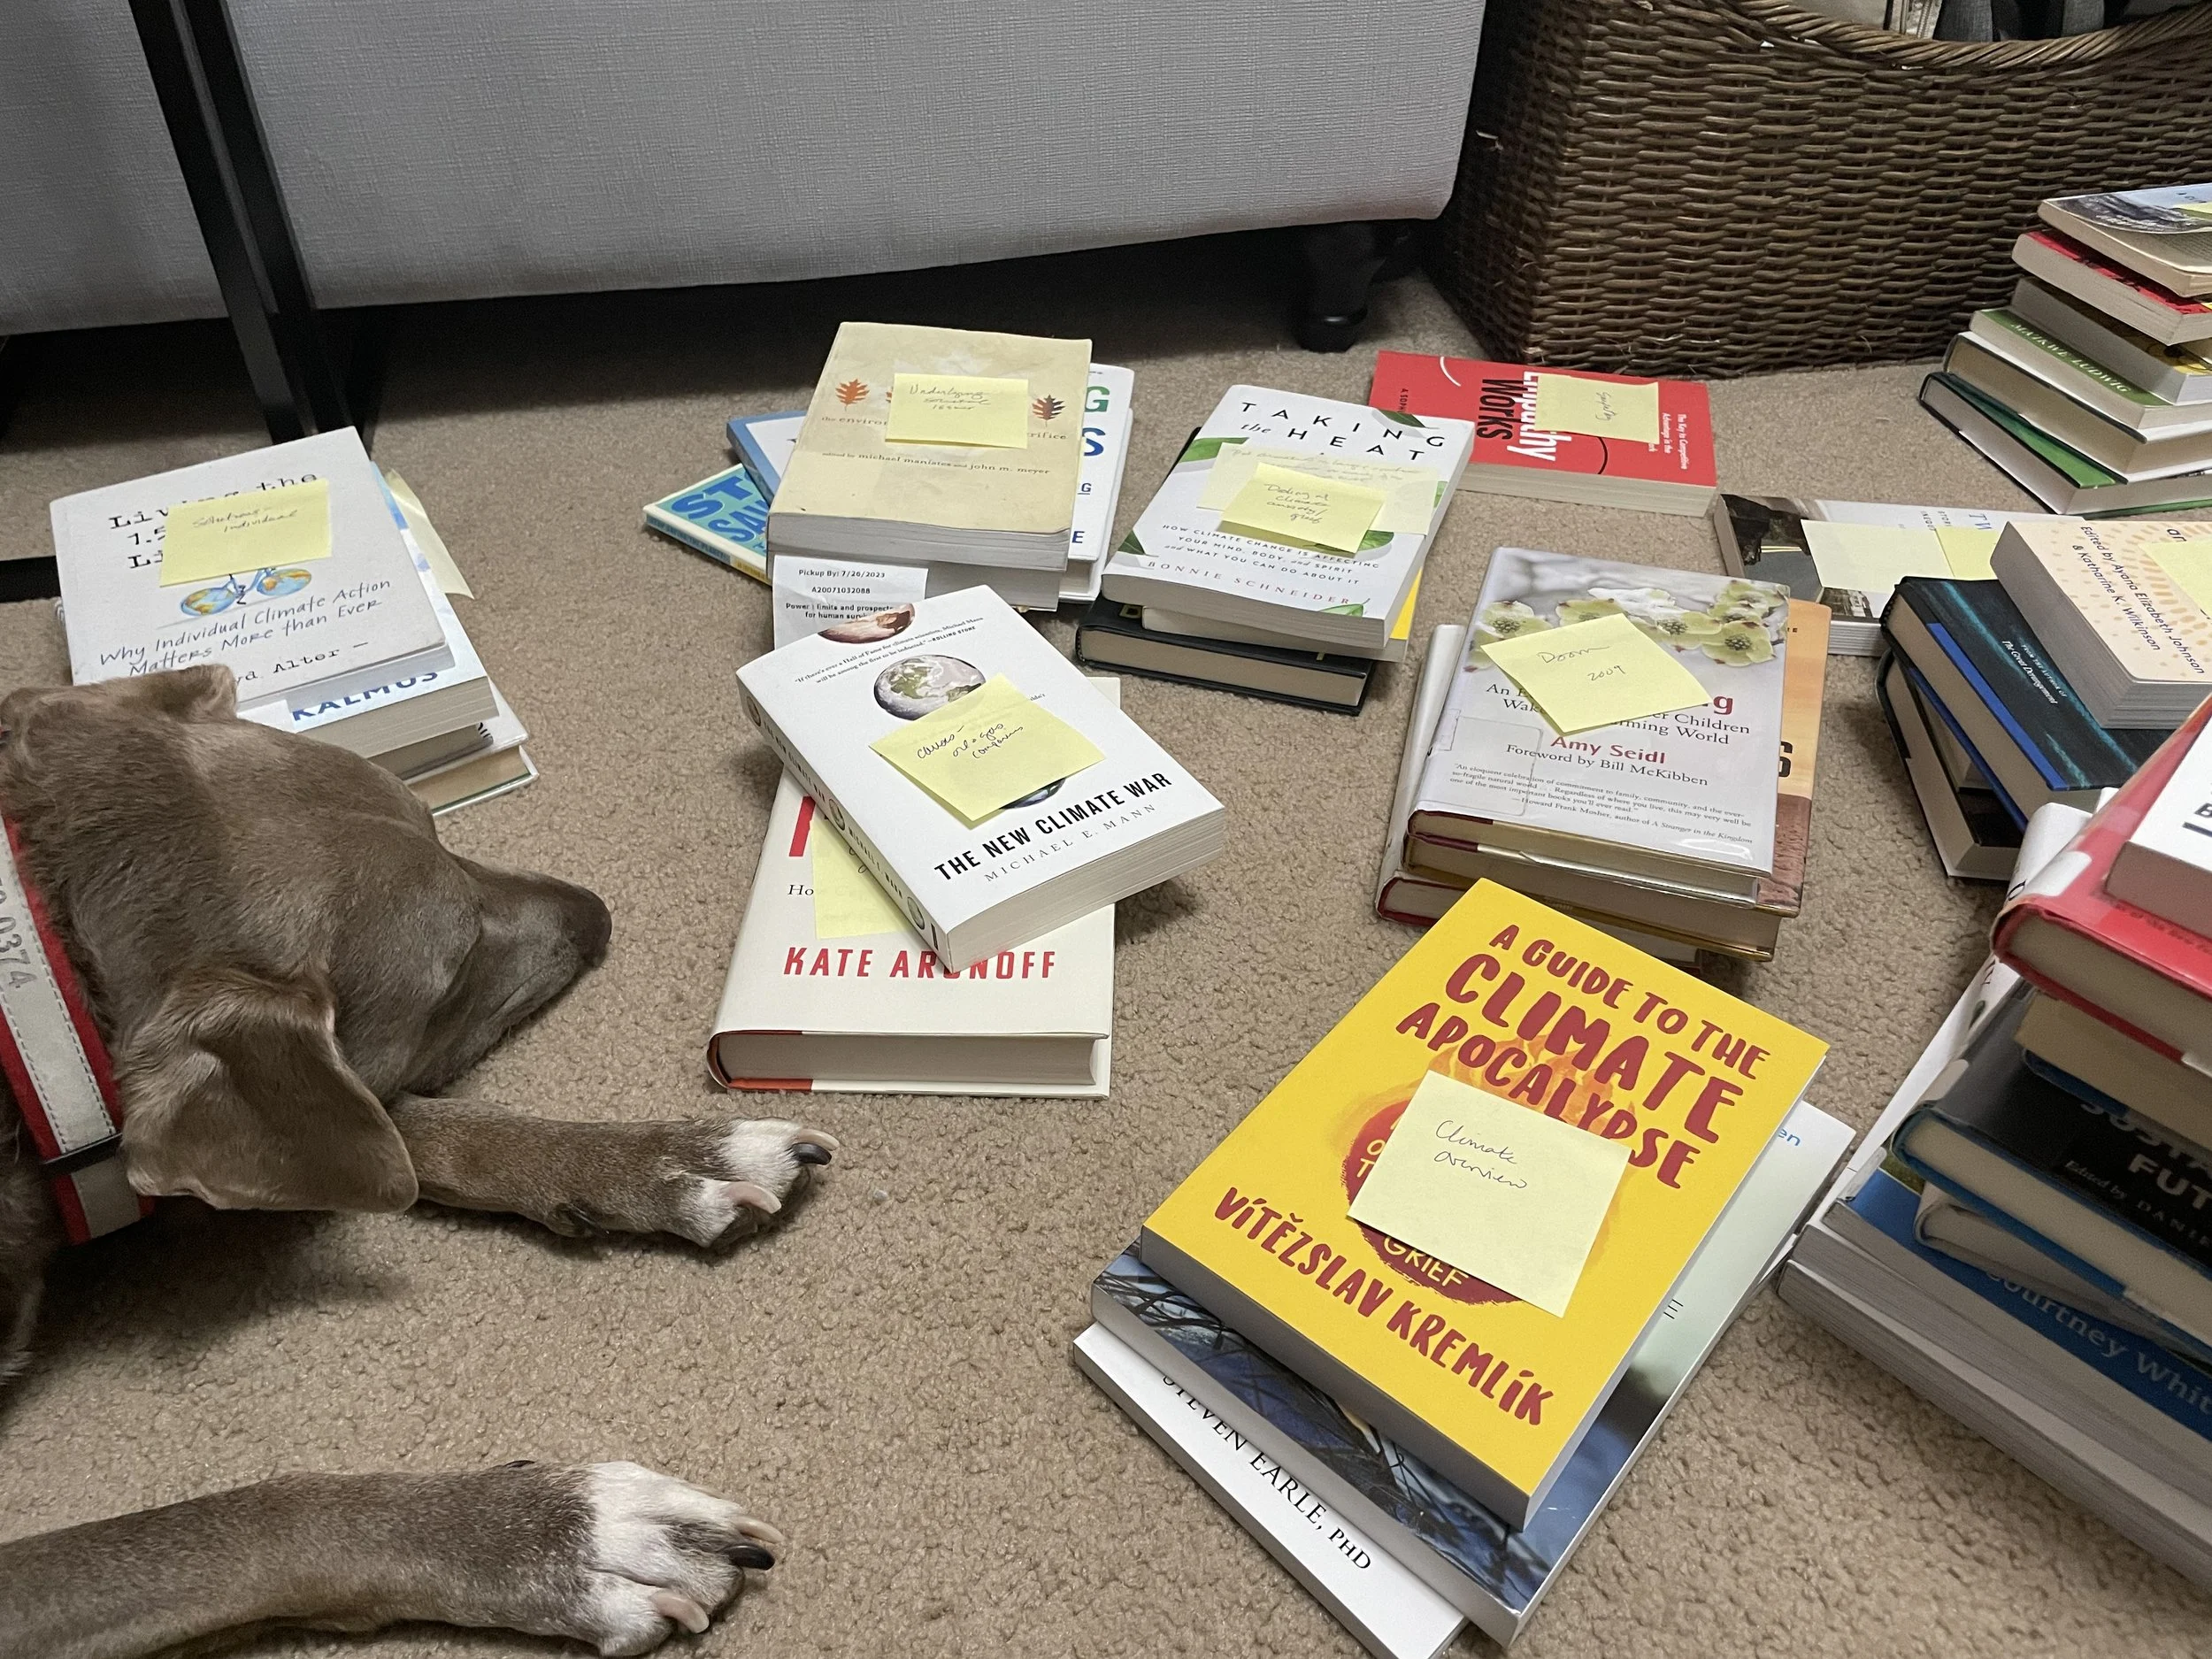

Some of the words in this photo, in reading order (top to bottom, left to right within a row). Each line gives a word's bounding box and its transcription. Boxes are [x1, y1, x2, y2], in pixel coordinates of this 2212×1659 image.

[2072, 359, 2131, 393] LUDWIG
[1240, 422, 1271, 434] the
[1287, 427, 1425, 461] HEAT
[1241, 402, 1445, 447] TAKING
[858, 453, 901, 463] michael
[904, 458, 951, 467] maniates
[969, 463, 996, 472] john
[1178, 536, 1208, 546] YOUR
[1314, 563, 1353, 574] SPIRIT
[1187, 547, 1218, 557] WHAT
[1224, 554, 1247, 564] YOU
[1252, 560, 1276, 571] CAN
[1302, 571, 1343, 583] ABOUT
[1193, 529, 1240, 542] CLIMATE
[1247, 540, 1293, 553] CHANGE
[1314, 553, 1380, 569] AFFECTING
[798, 569, 824, 578] Pickup
[1148, 561, 1222, 580] BONNIE
[1233, 577, 1350, 605] SCHNEIDER
[2078, 552, 2116, 594] Katharine
[2112, 595, 2126, 605] K.
[2123, 607, 2161, 650] Wilkinson
[2080, 526, 2107, 550] Edited
[2102, 552, 2116, 563] by
[2113, 563, 2138, 591] Ayana
[2134, 592, 2172, 634] Elizabeth
[2169, 632, 2205, 674] Johnson
[100, 646, 145, 666] Why
[156, 612, 247, 655] Individual
[254, 595, 327, 626] Climate
[333, 580, 391, 603] Action
[221, 629, 273, 651] More
[281, 614, 327, 638] than
[337, 599, 384, 618] Ever
[273, 648, 341, 674] Alter
[1537, 645, 1610, 664] Doom
[1587, 665, 1626, 681] 2009
[2002, 641, 2014, 650] The
[2011, 650, 2028, 666] Great
[2023, 666, 2058, 703] Derangement
[1486, 683, 1509, 695] An
[1674, 712, 1750, 734] Children
[1550, 736, 1601, 756] Amy
[1610, 745, 1665, 764] Seidl
[1678, 726, 1730, 745] World
[1507, 743, 1572, 763] Foreword
[1578, 753, 1594, 768] by
[1601, 759, 1624, 772] Bill
[1630, 764, 1709, 786] McKibben
[1470, 766, 1502, 777] eloquent
[1503, 772, 1545, 784] celebration
[1556, 781, 1603, 794] commitment
[1616, 789, 1641, 801] family,
[1644, 796, 1691, 810] community,
[1488, 776, 1514, 786] natural
[1516, 780, 1538, 789] world
[1555, 787, 1595, 799] Regardless
[1649, 803, 1665, 811] live,
[1685, 810, 1701, 819] may
[1703, 814, 1720, 823] very
[1723, 817, 1739, 826] well
[1509, 787, 1546, 798] important
[1548, 791, 1571, 803] books
[934, 849, 981, 880] THE
[982, 826, 1032, 858] NEW
[1035, 789, 1125, 834] CLIMATE
[1123, 772, 1172, 798] WAR
[984, 839, 1073, 882] MICHAEL
[1081, 830, 1098, 839] E.
[1103, 803, 1156, 831] MANN
[1555, 802, 1577, 812] Frank
[1580, 806, 1612, 819] Mosher,
[1615, 814, 1640, 823] author
[1661, 822, 1692, 833] Stranger
[1717, 832, 1753, 844] Kingdom
[784, 947, 873, 977] KATE
[889, 950, 1056, 979] ARNOFF
[1488, 924, 1519, 951] A
[1522, 939, 1633, 1009] GUIDE
[1633, 991, 1689, 1034] TO
[1691, 1019, 1770, 1079] THE
[1445, 953, 1744, 1144] CLIMATE
[1395, 1002, 1701, 1189] APOCALYPSE
[1384, 1237, 1470, 1287] GRIEF
[1214, 1187, 1394, 1317] VÍTĚZSLAV
[1386, 1300, 1554, 1425] KREMLÍK
[1986, 1271, 2128, 1358] ourtney
[1249, 1451, 1328, 1531] EARLE,
[1327, 1527, 1371, 1570] PHD
